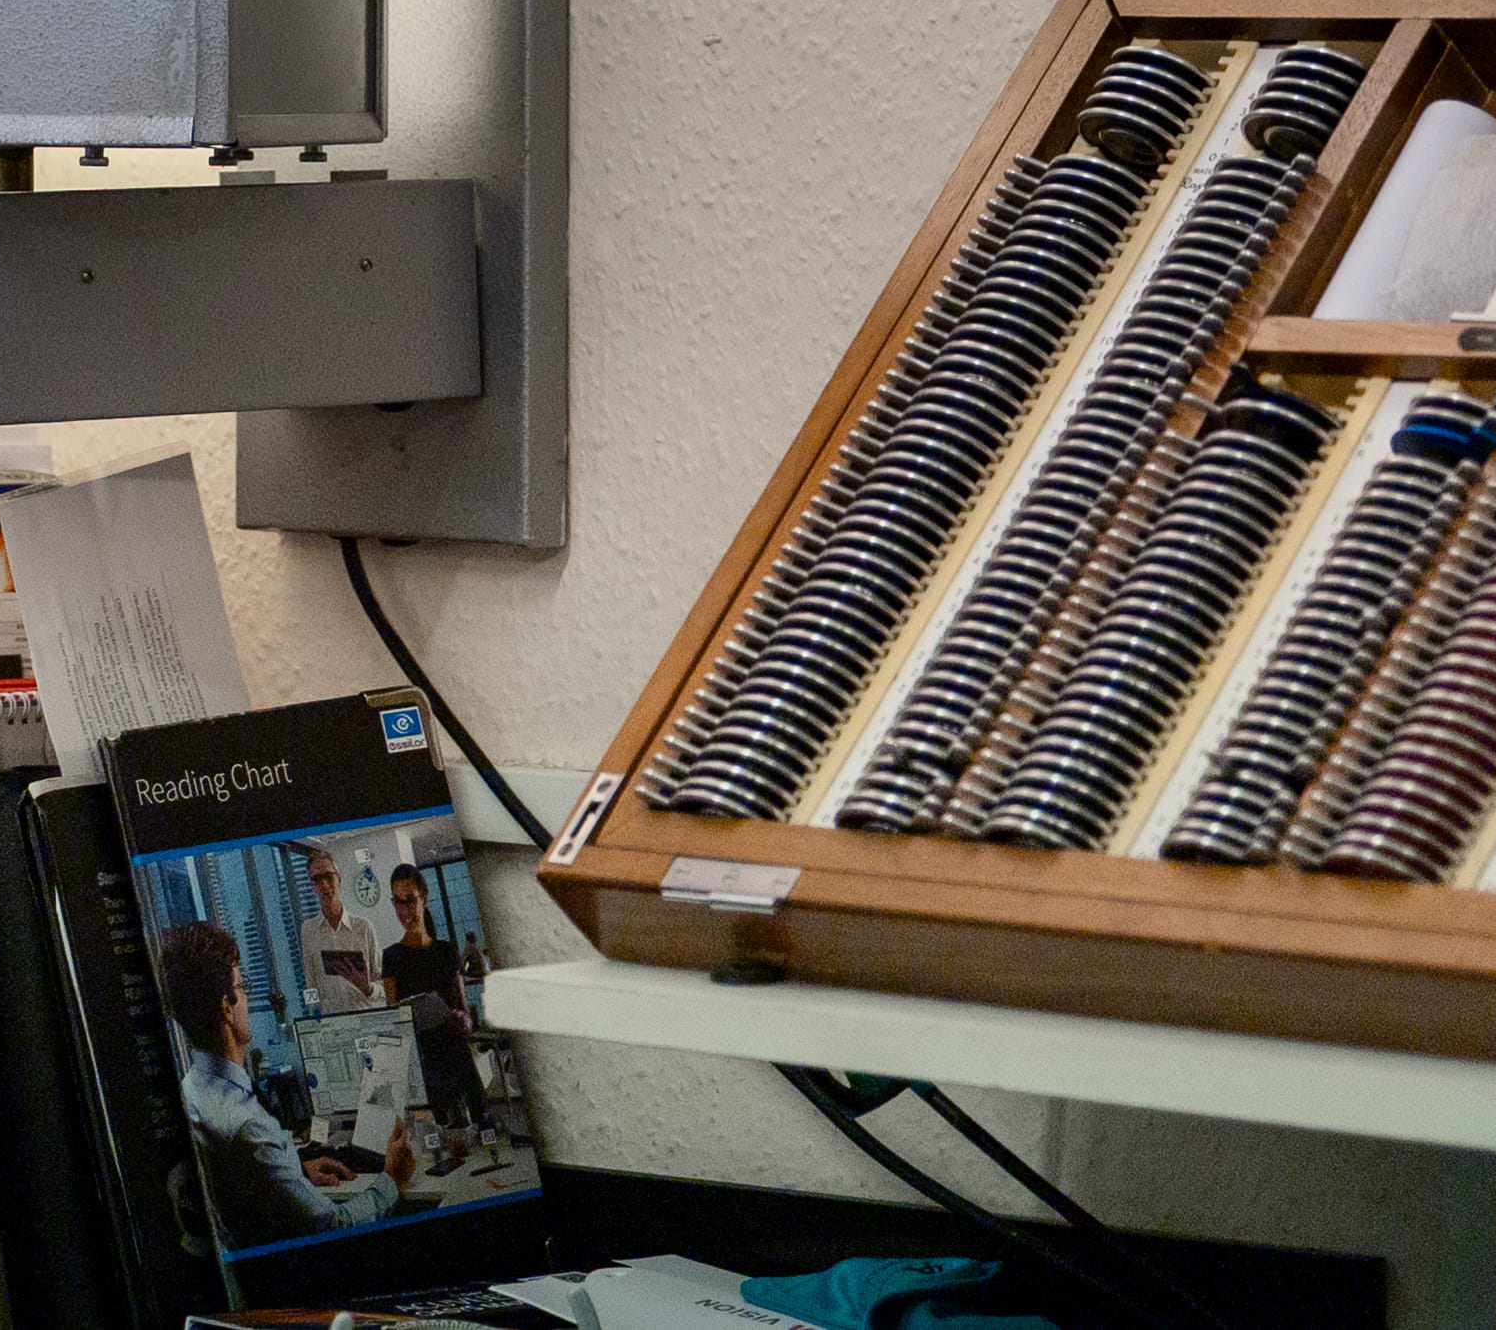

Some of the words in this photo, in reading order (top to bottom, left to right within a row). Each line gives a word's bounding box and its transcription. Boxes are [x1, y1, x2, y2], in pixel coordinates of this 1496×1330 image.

[136, 770, 228, 809] Reading
[232, 758, 292, 795] Chart
[694, 1298, 780, 1326] VISION
